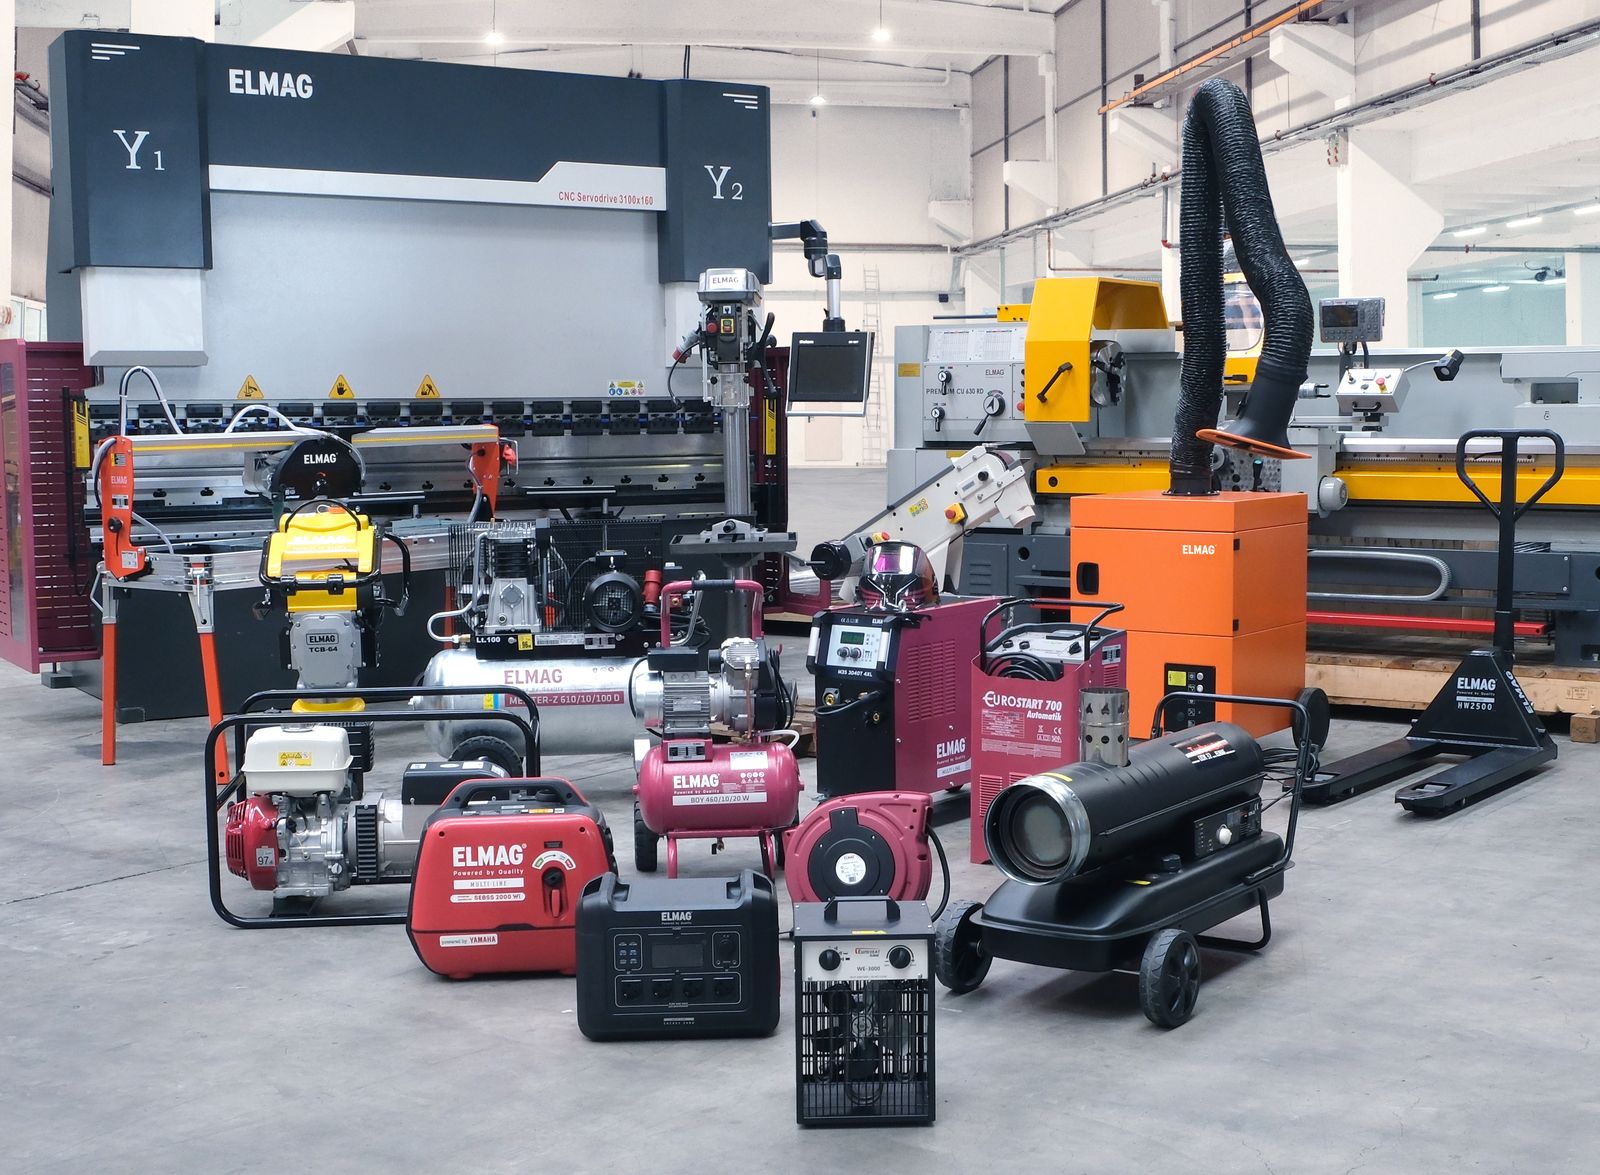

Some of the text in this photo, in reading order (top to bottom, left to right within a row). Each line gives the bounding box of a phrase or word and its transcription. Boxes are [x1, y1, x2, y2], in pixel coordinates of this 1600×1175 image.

[228, 69, 313, 99] ELMAG
[558, 192, 654, 205] CNC Servodrive 3100x160
[712, 276, 739, 284] ELMAG
[304, 454, 337, 464] ELMAG
[1182, 545, 1215, 555] ELMAG
[309, 635, 336, 643] ELMAG
[504, 669, 563, 685] ELMAG
[1457, 677, 1496, 691] ELMAG
[1505, 670, 1534, 714] ELMAG
[509, 695, 559, 705] METER-Z
[560, 695, 611, 704] 610/10/100
[1045, 701, 1062, 711] 700
[1457, 702, 1493, 711] HW2500
[1026, 710, 1062, 721] Automatik
[936, 738, 966, 759] ELMAG
[673, 774, 720, 788] ELMAG
[257, 856, 269, 865] 97
[452, 844, 524, 867] ELMAG
[661, 912, 692, 921] ELMAG
[470, 936, 496, 944] YAMAHA
